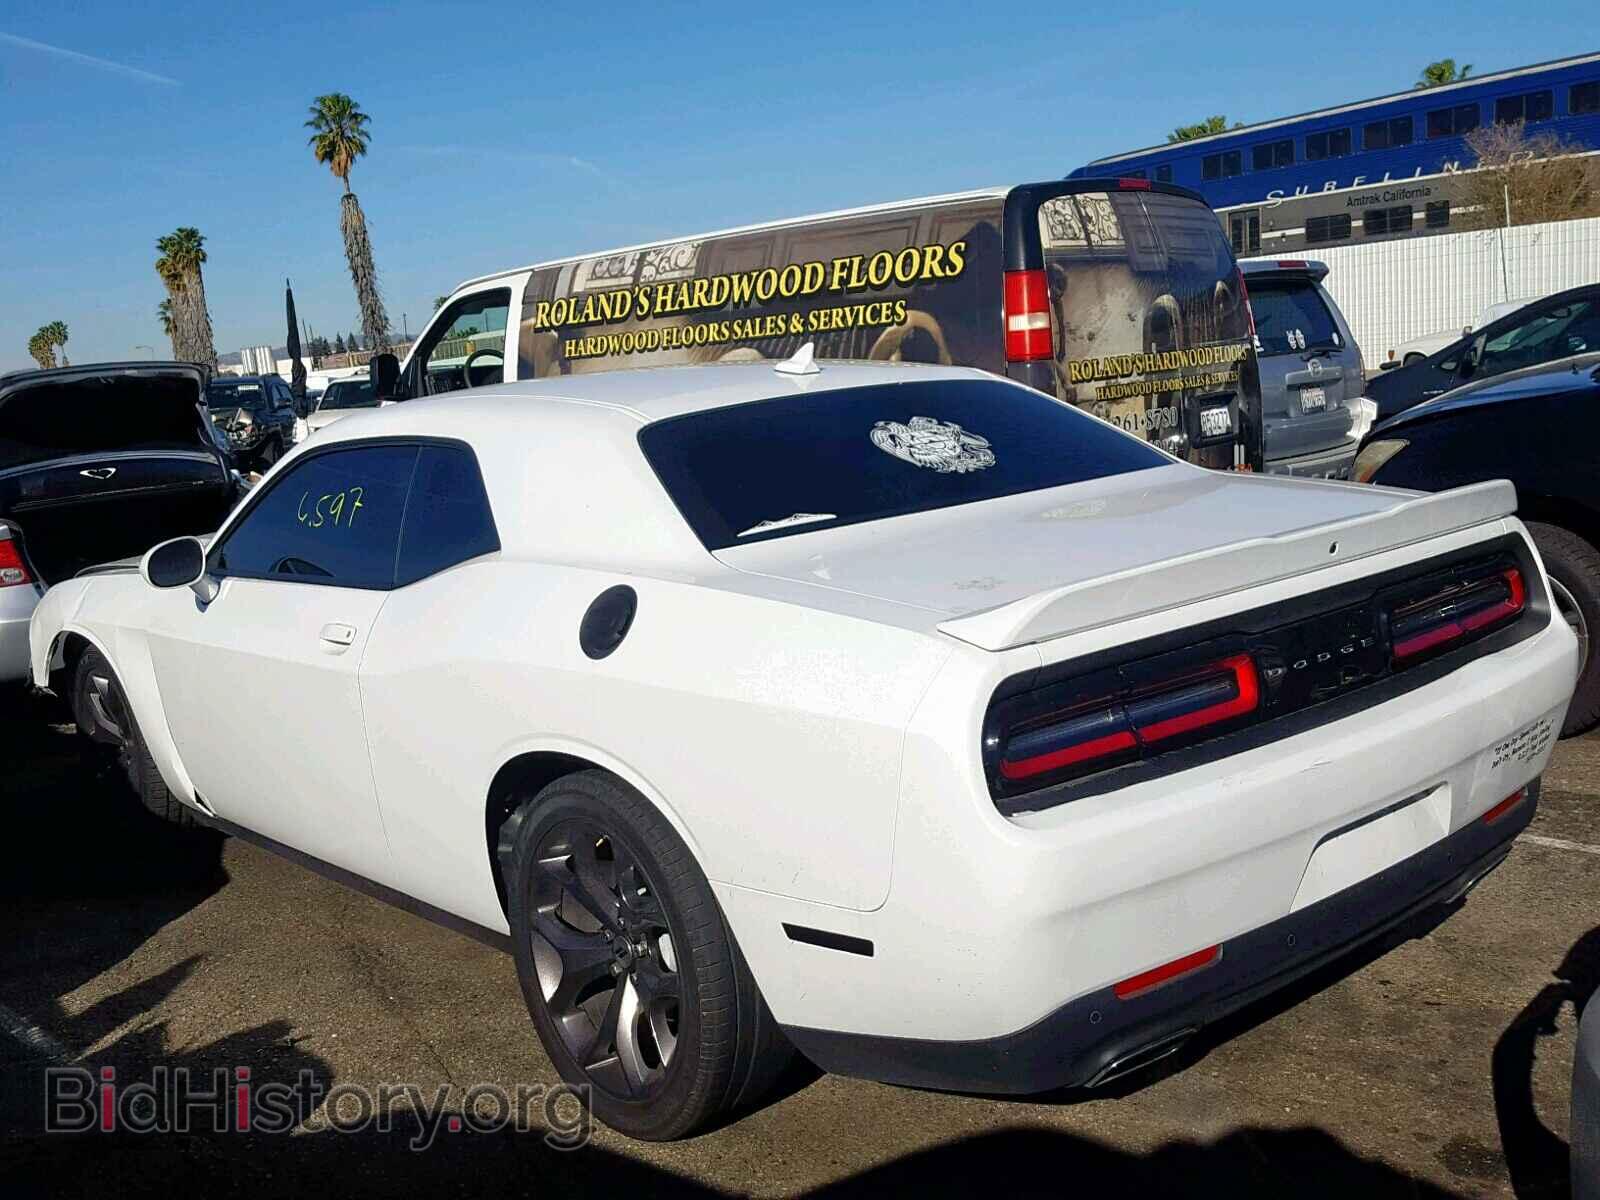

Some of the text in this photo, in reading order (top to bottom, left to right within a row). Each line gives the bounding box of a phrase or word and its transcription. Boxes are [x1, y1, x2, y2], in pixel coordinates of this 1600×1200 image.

[1346, 186, 1433, 207] Amtrak California
[533, 241, 966, 331] ROLAND'S HARDWOOD FLOORS
[564, 299, 907, 358] HARDWOOD FLOORS SALES & SERVICES
[1070, 344, 1248, 382] ROLAND'S HARDWOOD FLOORS
[1096, 370, 1240, 401] HARDWOOD FLOORS SALES & SERVICES
[1265, 637, 1375, 680] DODGE
